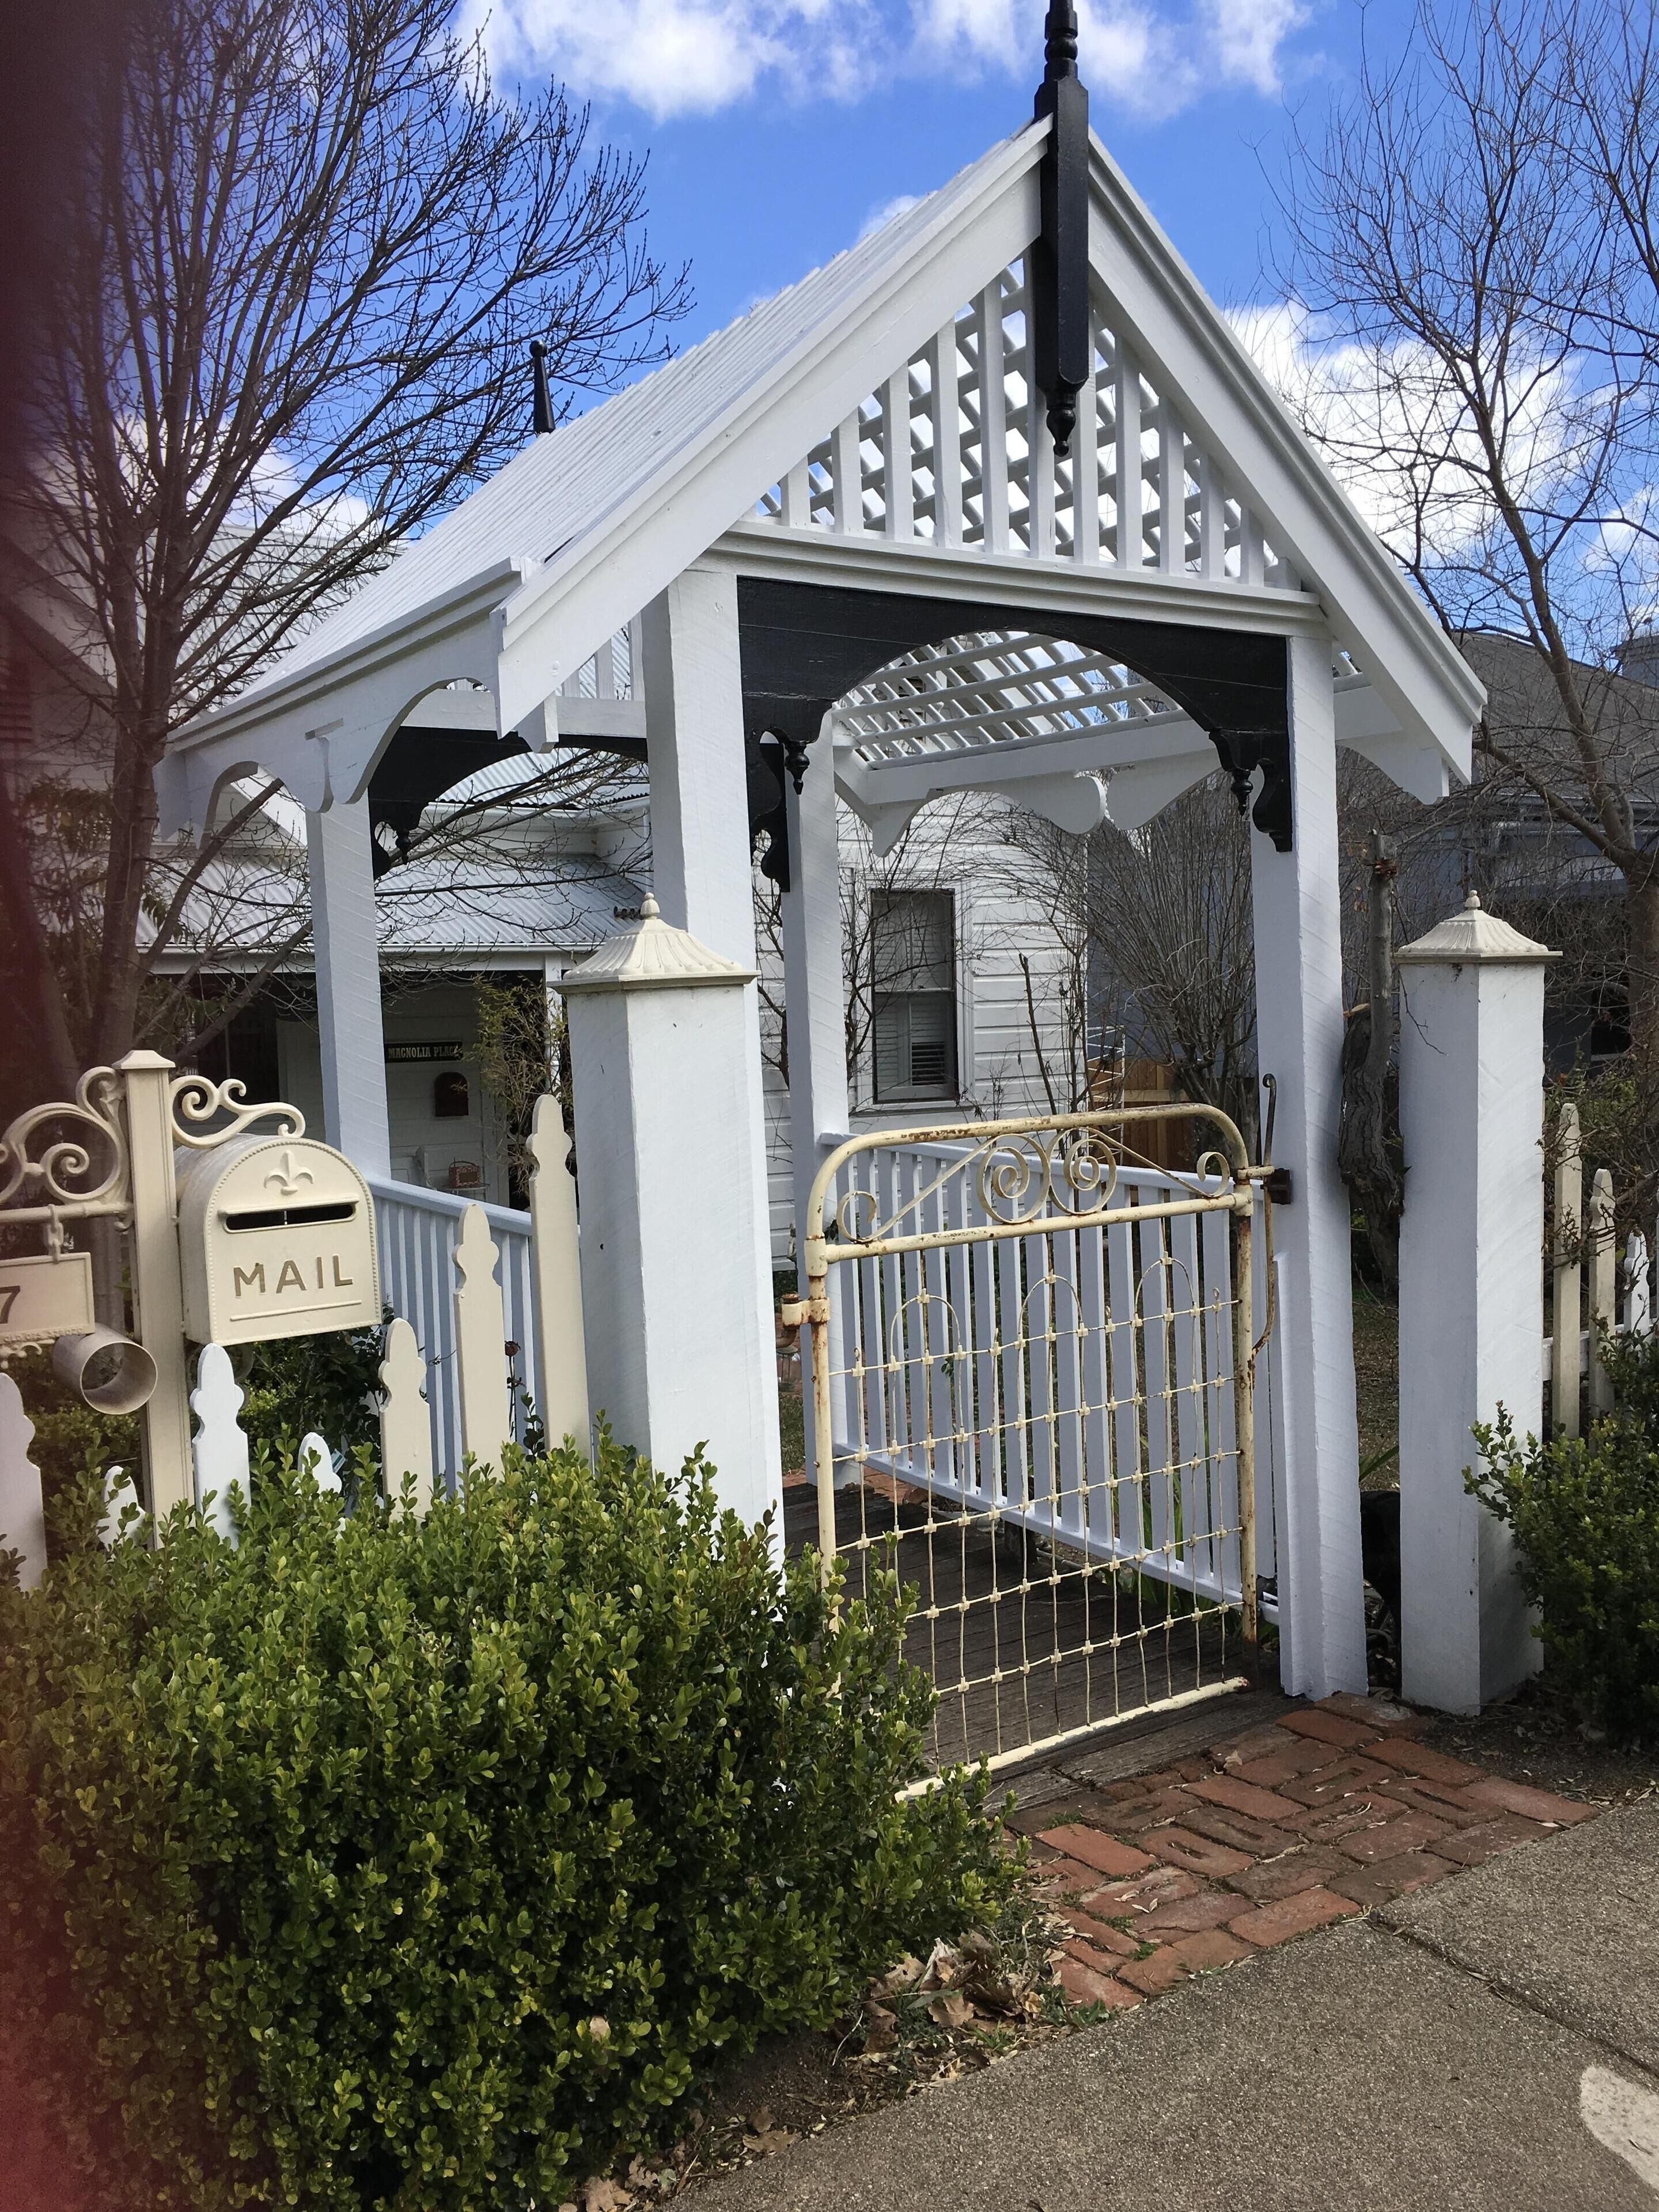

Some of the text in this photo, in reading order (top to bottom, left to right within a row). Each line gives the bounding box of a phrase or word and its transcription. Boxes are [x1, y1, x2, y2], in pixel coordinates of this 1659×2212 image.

[388, 1046, 459, 1058] MAGNOLIA PLAC
[233, 1254, 353, 1298] MAIL
[0, 1285, 21, 1324] 7
